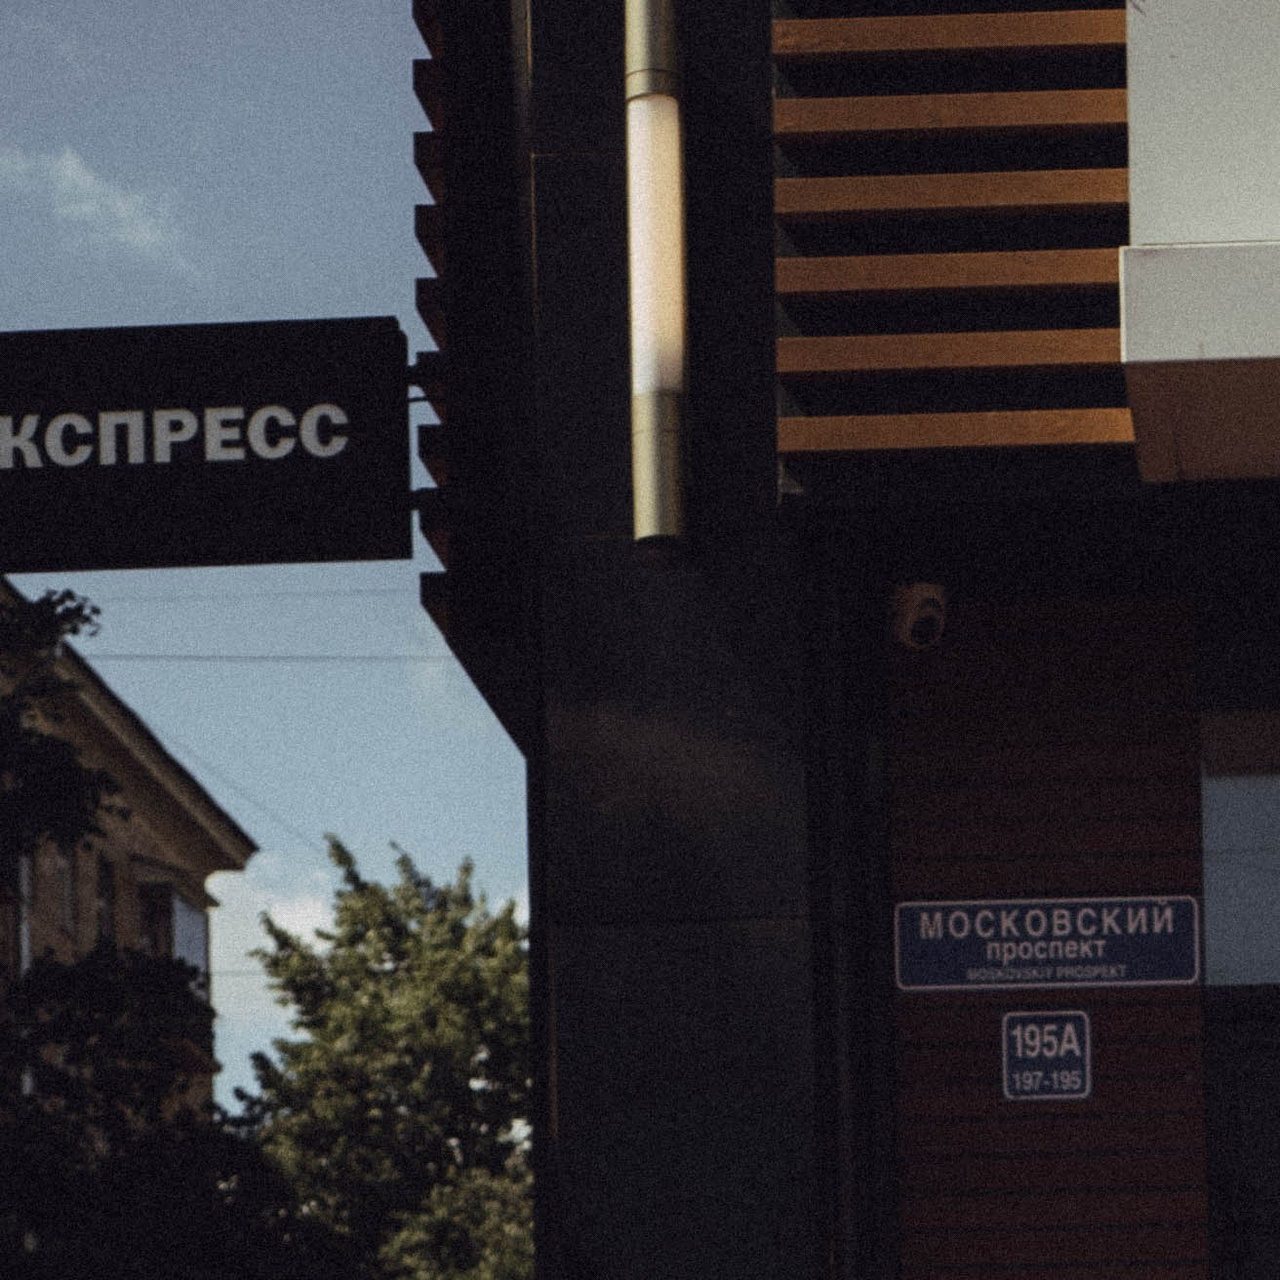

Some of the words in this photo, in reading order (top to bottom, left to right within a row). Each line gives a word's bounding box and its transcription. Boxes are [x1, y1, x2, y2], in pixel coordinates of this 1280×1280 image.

[919, 901, 1174, 939] МОСКОВСКИЙ
[986, 939, 1106, 965] проспект
[1012, 1070, 1081, 1090] 197-195
